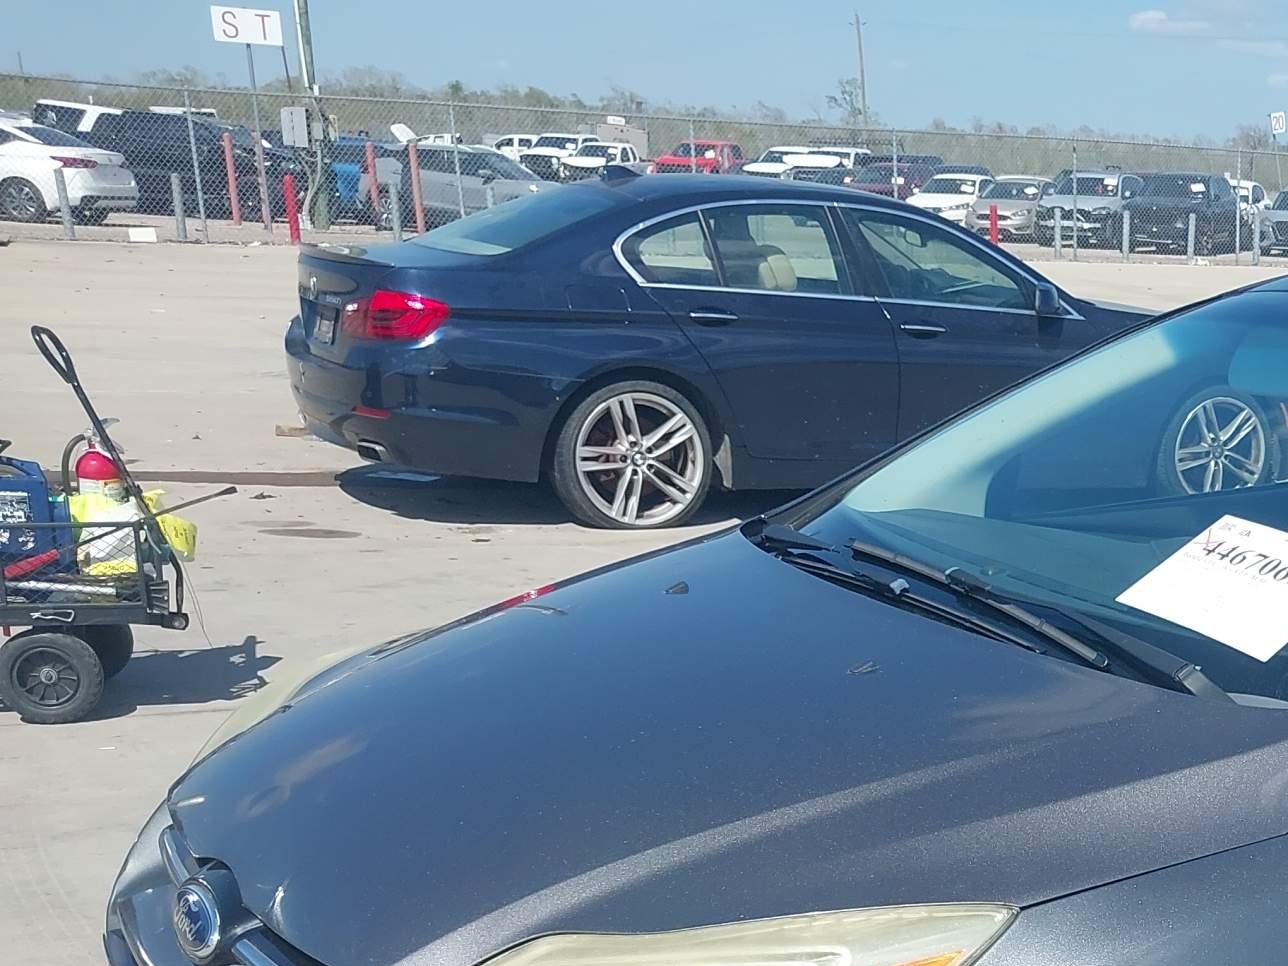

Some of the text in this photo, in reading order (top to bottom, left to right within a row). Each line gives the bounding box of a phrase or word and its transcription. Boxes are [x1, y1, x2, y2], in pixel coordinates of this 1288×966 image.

[221, 11, 271, 41] S T
[1272, 114, 1284, 131] 20
[174, 894, 202, 941] Ford
